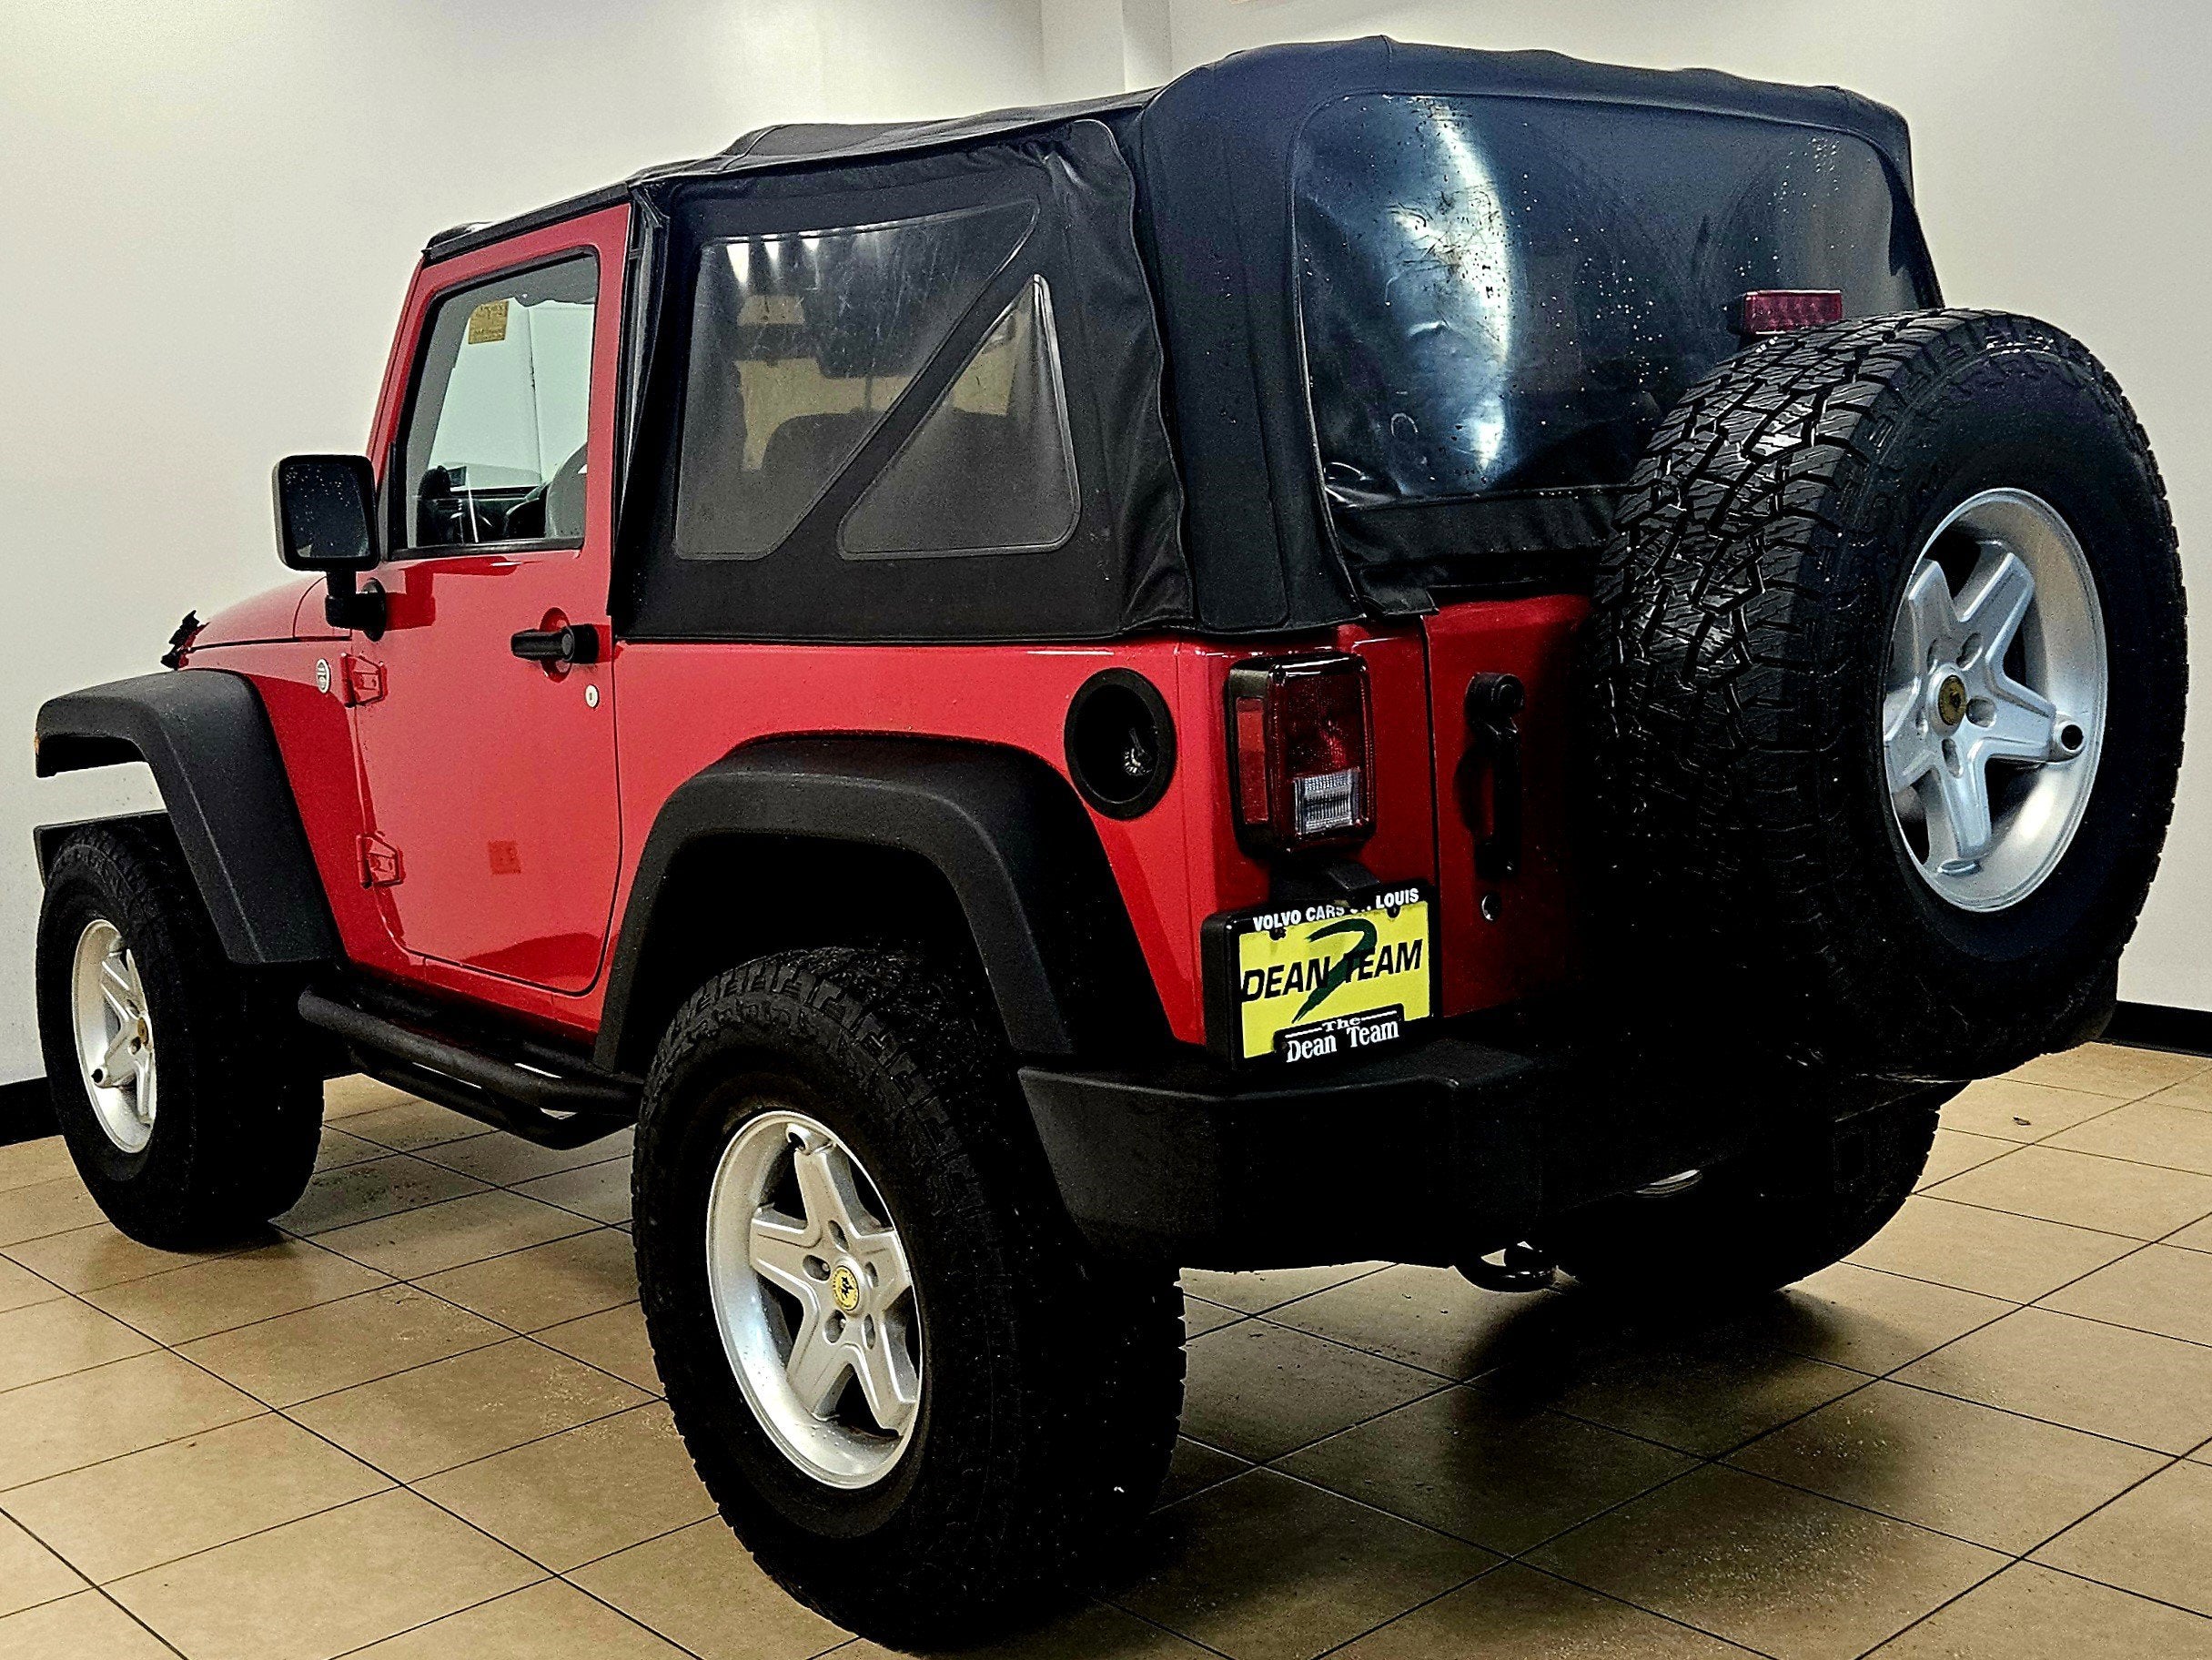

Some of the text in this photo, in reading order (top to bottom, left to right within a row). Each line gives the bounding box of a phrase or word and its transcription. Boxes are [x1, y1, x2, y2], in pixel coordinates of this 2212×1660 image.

[1253, 910, 1301, 931] VOLVO
[1305, 905, 1345, 921] CARS
[1375, 887, 1419, 909] LOUIS
[1240, 938, 1424, 1003] DEAN TEAM
[1286, 1020, 1399, 1063] Dean Team
[1322, 1017, 1361, 1032] The
